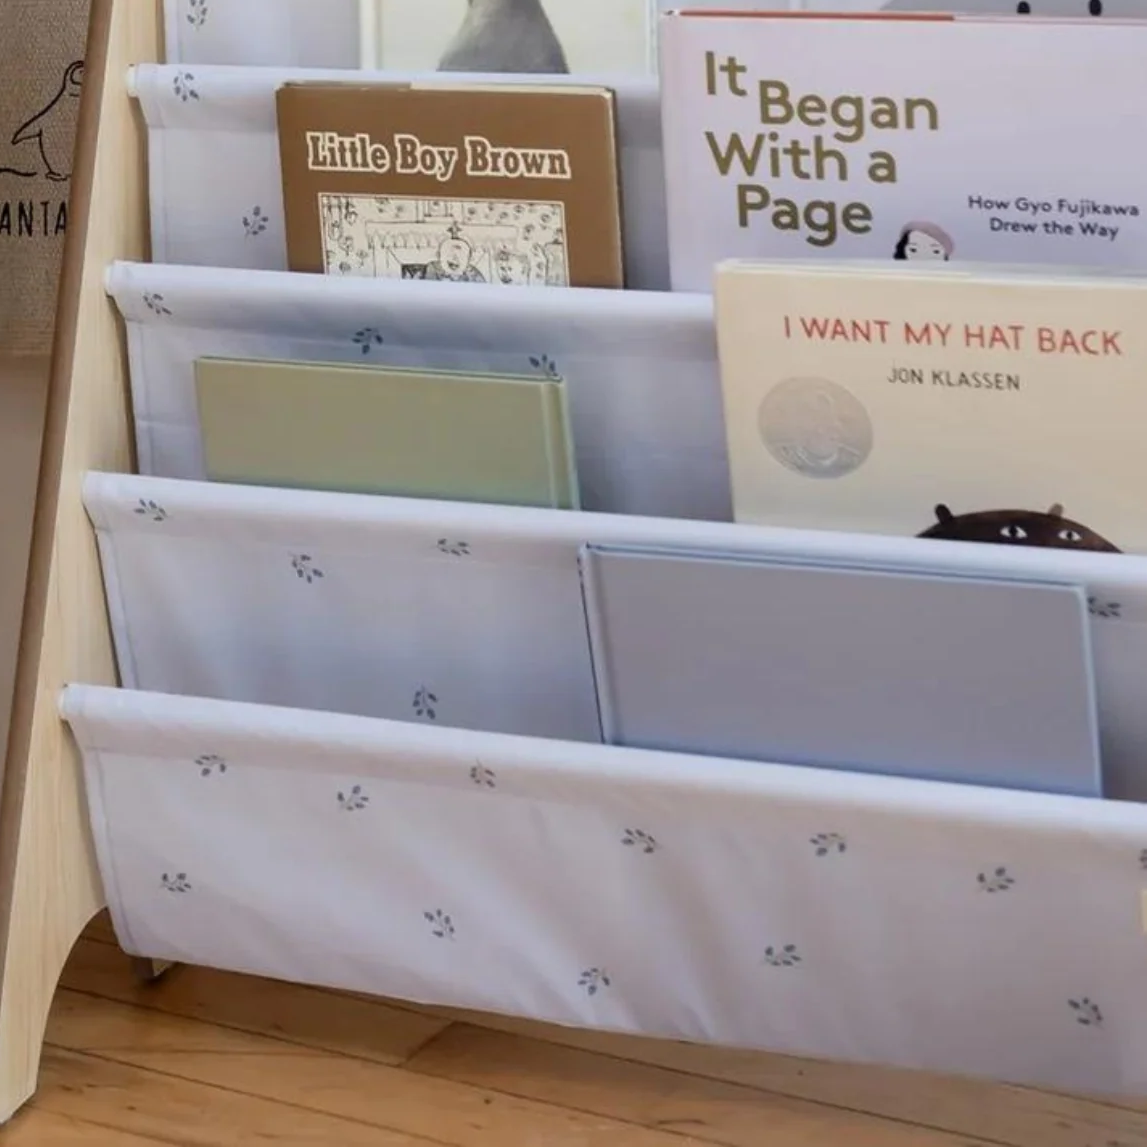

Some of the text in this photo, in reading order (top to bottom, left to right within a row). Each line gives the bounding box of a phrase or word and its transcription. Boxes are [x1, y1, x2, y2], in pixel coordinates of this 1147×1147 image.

[706, 51, 747, 96] It
[759, 80, 938, 143] Began
[306, 131, 571, 181] Little Boy Brown
[705, 132, 896, 183] With a
[737, 184, 872, 247] Page
[969, 196, 1139, 218] How Gyo Fujikawa
[990, 217, 1119, 241] Drew the Way
[783, 315, 1121, 355] I WANT MY HAT BACK
[887, 367, 1020, 390] JON KLASSEN
